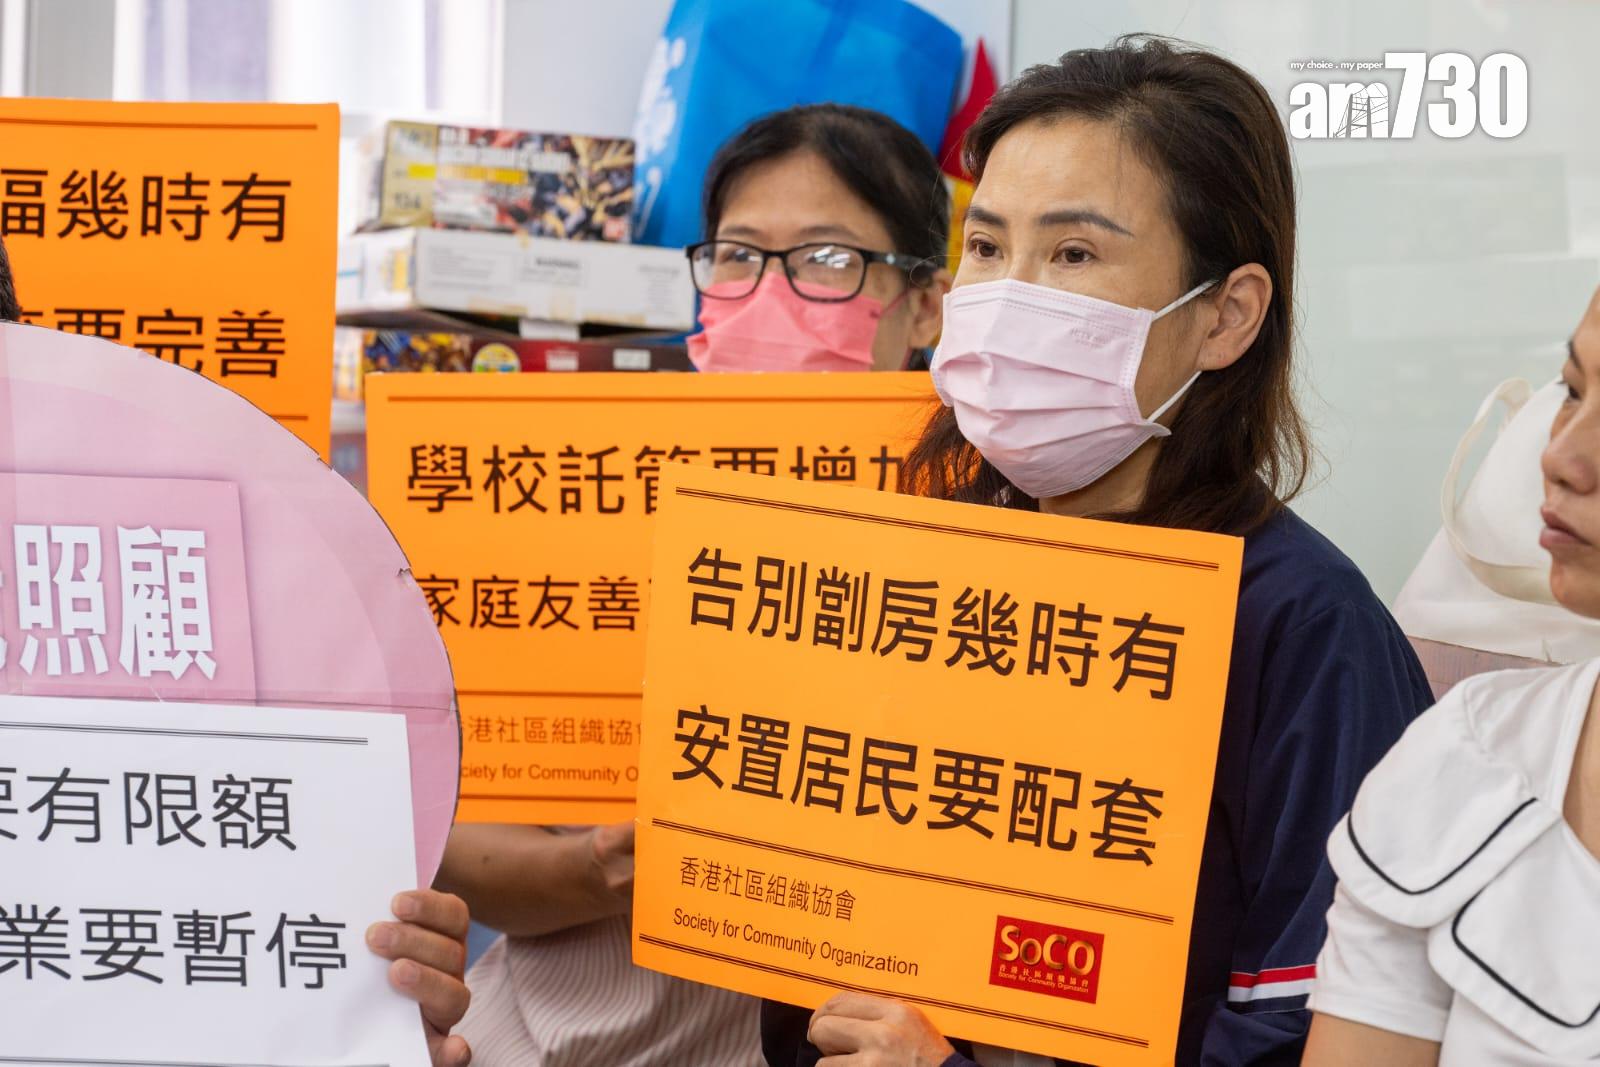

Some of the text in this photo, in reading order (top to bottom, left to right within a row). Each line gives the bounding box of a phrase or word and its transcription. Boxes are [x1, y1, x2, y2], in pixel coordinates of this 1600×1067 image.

[0, 524, 217, 681] 照顧
[416, 574, 652, 631] 家庭友善
[686, 546, 1186, 701] 告別劏房幾時有
[462, 715, 642, 746] 港社區組織協
[0, 766, 298, 852] 有限額
[461, 764, 498, 782] ciety
[502, 763, 523, 779] for
[528, 764, 621, 785] Community
[672, 703, 1165, 867] 安置居民要配套
[679, 856, 857, 923] 香港社區組織協會
[0, 903, 349, 990] 業要暫停
[673, 907, 919, 977] Society for Community Organization
